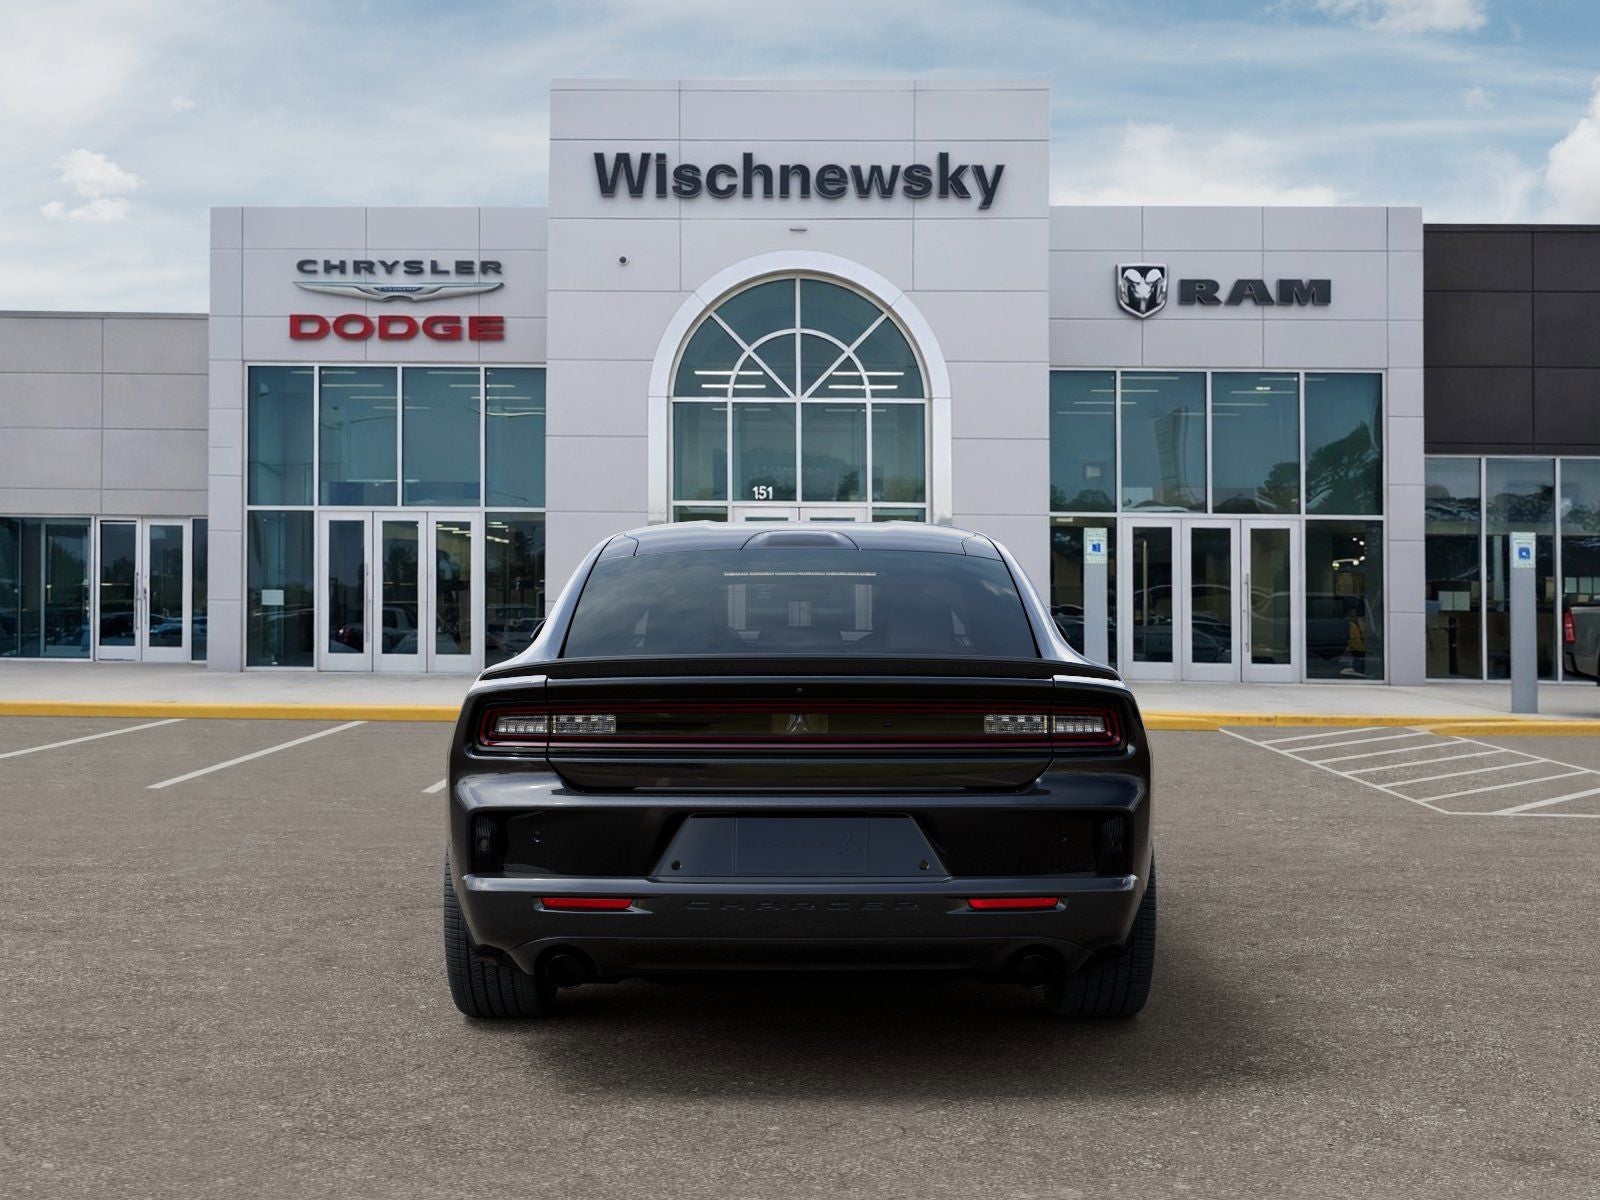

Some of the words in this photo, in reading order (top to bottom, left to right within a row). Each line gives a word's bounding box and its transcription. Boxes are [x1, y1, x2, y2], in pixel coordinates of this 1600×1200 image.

[593, 152, 1006, 210] Wischnewsky
[296, 259, 503, 275] CHRYSLER
[1177, 279, 1332, 306] RAM
[289, 314, 505, 341] DODGE
[752, 485, 773, 500] 151
[684, 899, 920, 911] CHARGER
